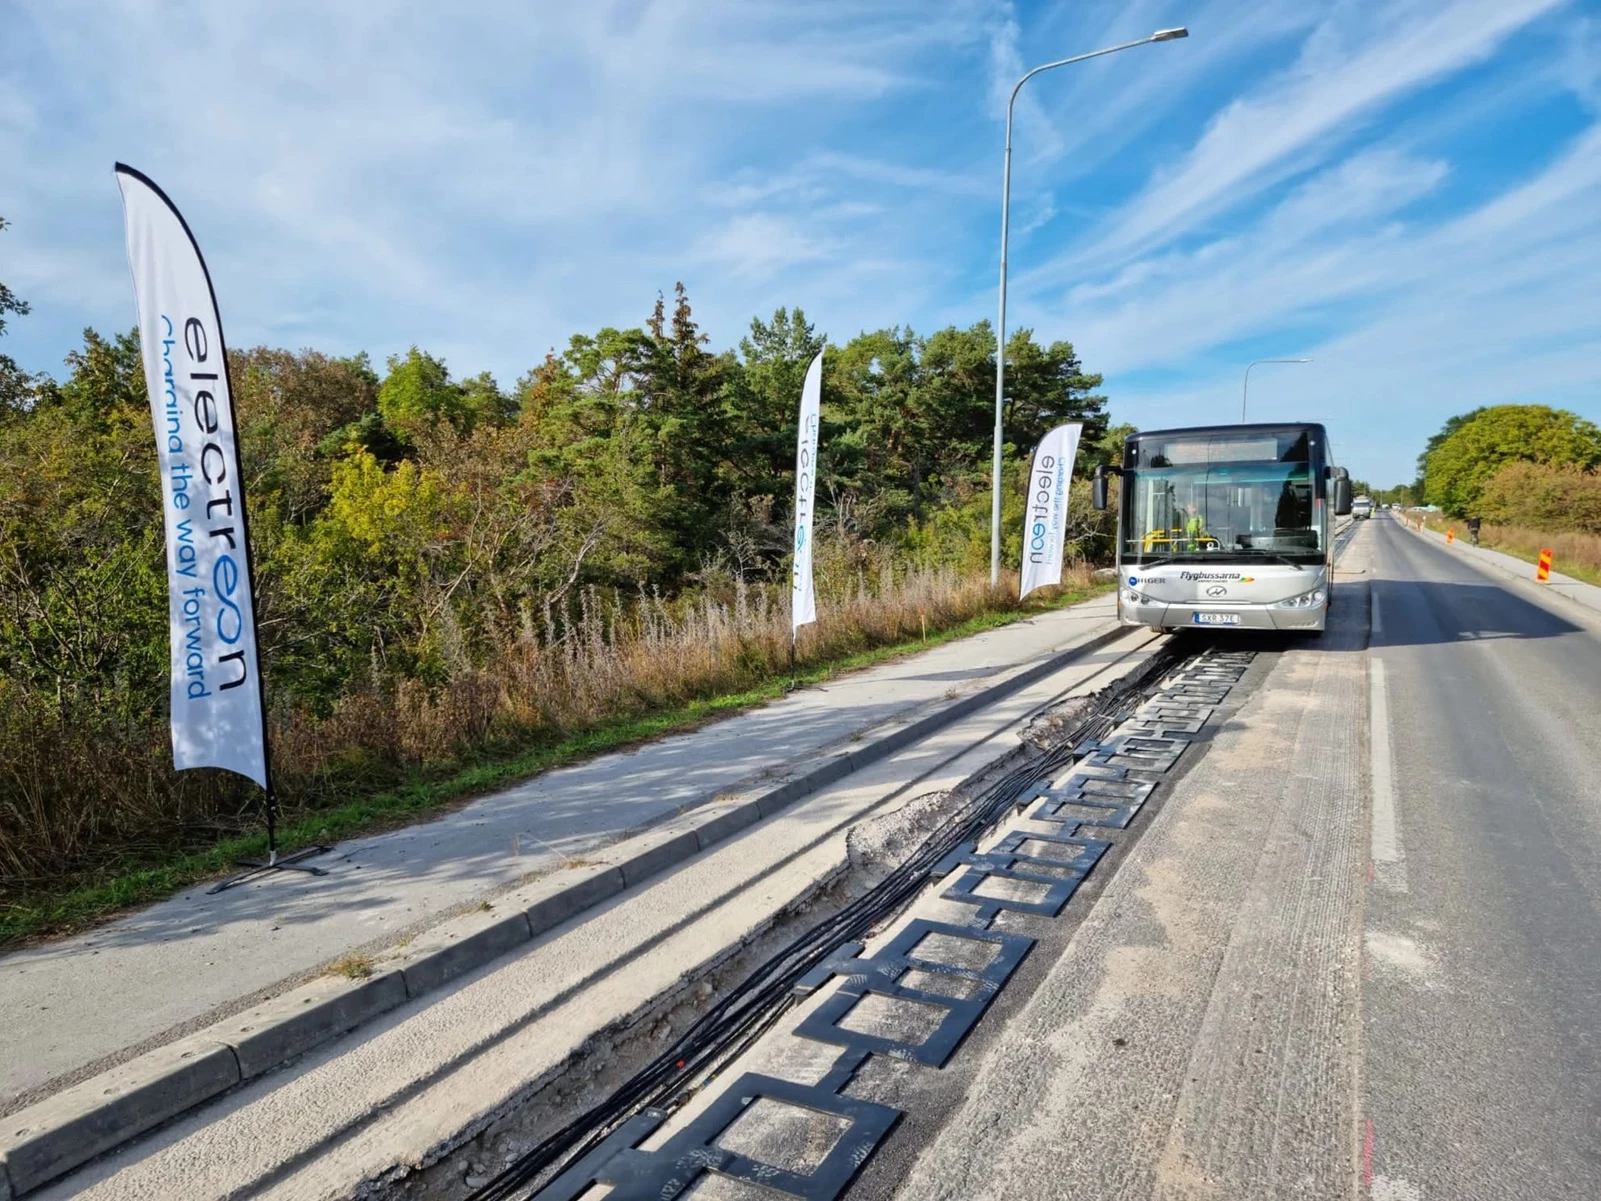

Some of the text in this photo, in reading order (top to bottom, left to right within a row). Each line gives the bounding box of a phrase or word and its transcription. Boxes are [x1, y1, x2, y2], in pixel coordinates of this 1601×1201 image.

[171, 463, 193, 510] the
[184, 316, 247, 691] electreon
[176, 519, 197, 578] way
[1180, 571, 1241, 581] Flygbussarna
[182, 586, 212, 700] forward
